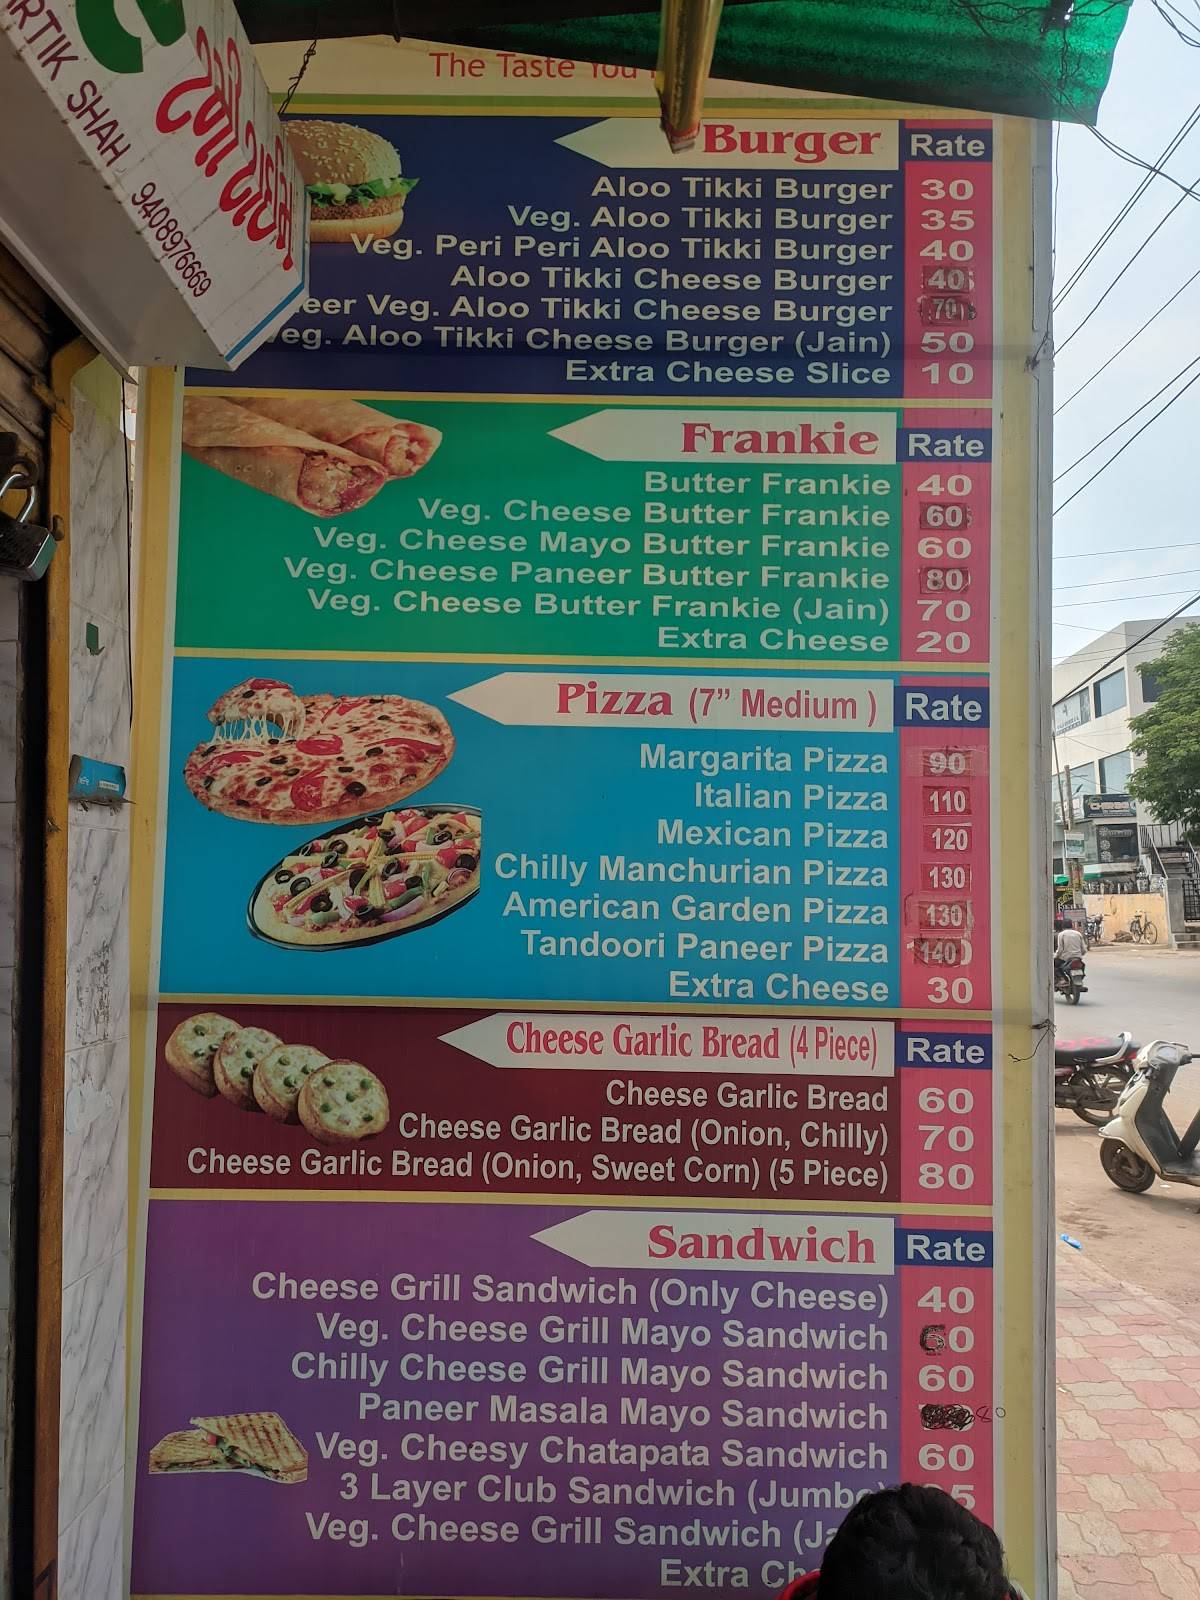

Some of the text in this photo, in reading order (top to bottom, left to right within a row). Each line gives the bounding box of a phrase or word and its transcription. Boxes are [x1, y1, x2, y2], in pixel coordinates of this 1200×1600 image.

[429, 53, 485, 78] The
[496, 53, 575, 78] Taste
[7, 0, 79, 81] RTIK
[67, 80, 131, 167] SHAH
[132, 182, 212, 297] 9408976669
[703, 124, 881, 164] Burger
[910, 134, 985, 157] Rate
[592, 177, 893, 204] Aloo Tikki Burger
[920, 179, 974, 200] 30
[351, 234, 893, 265] Veg. Peri Peri Aloo Tikki Burger
[919, 240, 974, 261] 40
[451, 266, 892, 296] Aloo Tikki Cheese Burger
[928, 269, 964, 290] 40
[367, 295, 892, 327] Veg. Aloo Tikki Cheese Burger
[267, 325, 890, 358] eg. Aloo Tikki Cheese Burger (Jain)
[920, 332, 974, 354] 50
[567, 360, 890, 384] Extra Cheese Slice
[921, 363, 974, 385] 10
[682, 421, 879, 455] Frankie
[908, 434, 985, 457] Rate
[646, 472, 890, 495] Butter Frankie
[917, 474, 972, 496] 40
[418, 498, 890, 527] Veg. Cheese Butter Frankie
[926, 505, 963, 528] 60
[314, 527, 890, 558] Veg. Cheese Mayo Butter Frankie
[917, 537, 972, 559] 60
[308, 589, 888, 625] Veg. Cheese Butter Frankie (Jain)
[917, 600, 971, 622] 70
[659, 627, 888, 652] Extra Cheese
[916, 631, 971, 653] 20
[557, 683, 673, 717] Pizza
[742, 689, 857, 721] Medium
[905, 692, 982, 722] Rate
[641, 744, 887, 776] Margarita Pizza
[929, 752, 966, 775] 90
[696, 782, 887, 811] Italian Pizza
[929, 790, 966, 813] 110
[495, 853, 888, 886] Chilly Manchurian Pizza
[929, 866, 966, 889] 130
[503, 892, 888, 925] American Garden Pizza
[926, 904, 963, 927] 130
[521, 930, 888, 963] Tandoori Paneer Pizza
[670, 971, 888, 1001] Extra Cheese
[927, 977, 974, 1004] 30
[507, 1021, 877, 1069] Cheese Garlic Bread (4 Piece)
[907, 1038, 985, 1064] Rate
[607, 1080, 887, 1111] Cheese Garlic Bread
[918, 1087, 974, 1114] 60
[400, 1113, 887, 1156] Cheese Garlic Bread (Onion, Chilly)
[918, 1125, 974, 1152] 70
[188, 1148, 887, 1194] Cheese Garlic Bread (Onion, Sweet Corn) (5 Piece)
[918, 1163, 975, 1190] 80
[648, 1225, 876, 1263] Sandwich
[907, 1234, 985, 1262] Rate
[253, 1272, 888, 1318] Cheese Grill Sandwich (Only Cheese)
[918, 1286, 975, 1314] 40
[317, 1313, 887, 1352] Veg. Cheese Grill Mayo Sandwich
[360, 1393, 479, 1421] Paneer
[491, 1395, 607, 1424] Masala
[621, 1398, 710, 1432] Mayo
[722, 1400, 887, 1429] Sandwich
[316, 1432, 887, 1472] Veg. Cheesy Chatapata Sandwich
[918, 1443, 975, 1471] 60
[340, 1473, 734, 1507] 3 Layer Club Sandwich
[305, 1512, 378, 1547] Veg.
[392, 1513, 519, 1542] Cheese
[532, 1516, 601, 1543] Grill
[614, 1517, 780, 1547] Sandwich
